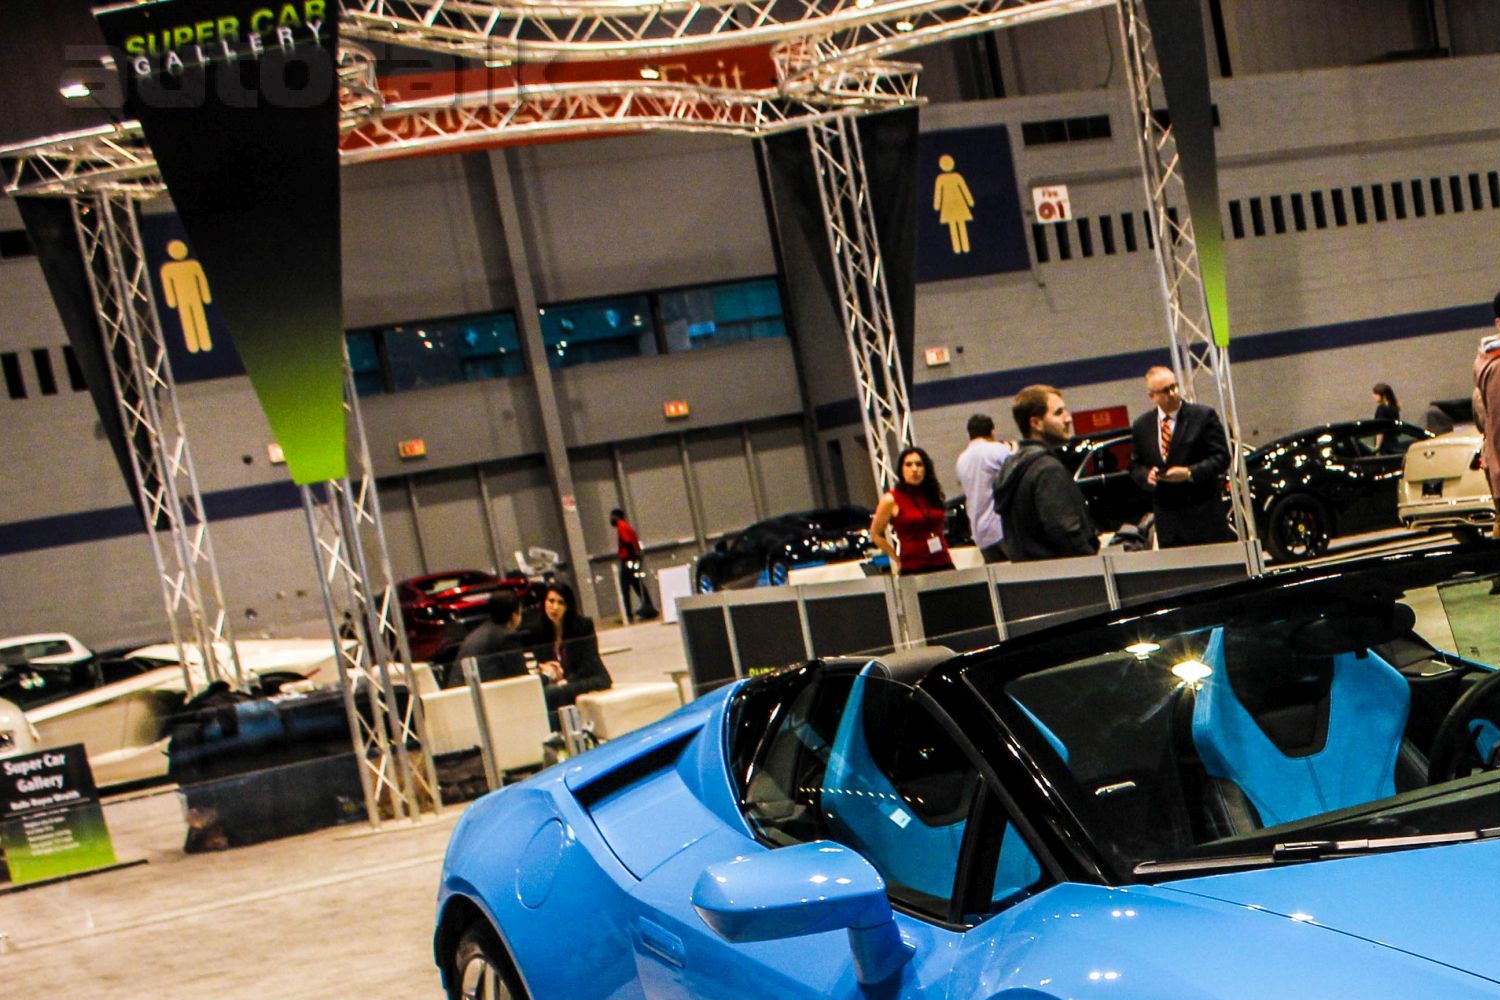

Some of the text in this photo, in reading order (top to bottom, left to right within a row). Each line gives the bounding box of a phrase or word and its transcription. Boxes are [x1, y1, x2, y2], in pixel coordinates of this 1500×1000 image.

[125, 0, 327, 56] SUPER CAR
[134, 20, 323, 76] GALLERY
[2, 753, 67, 776] Super Car
[16, 774, 64, 793] Gallery
